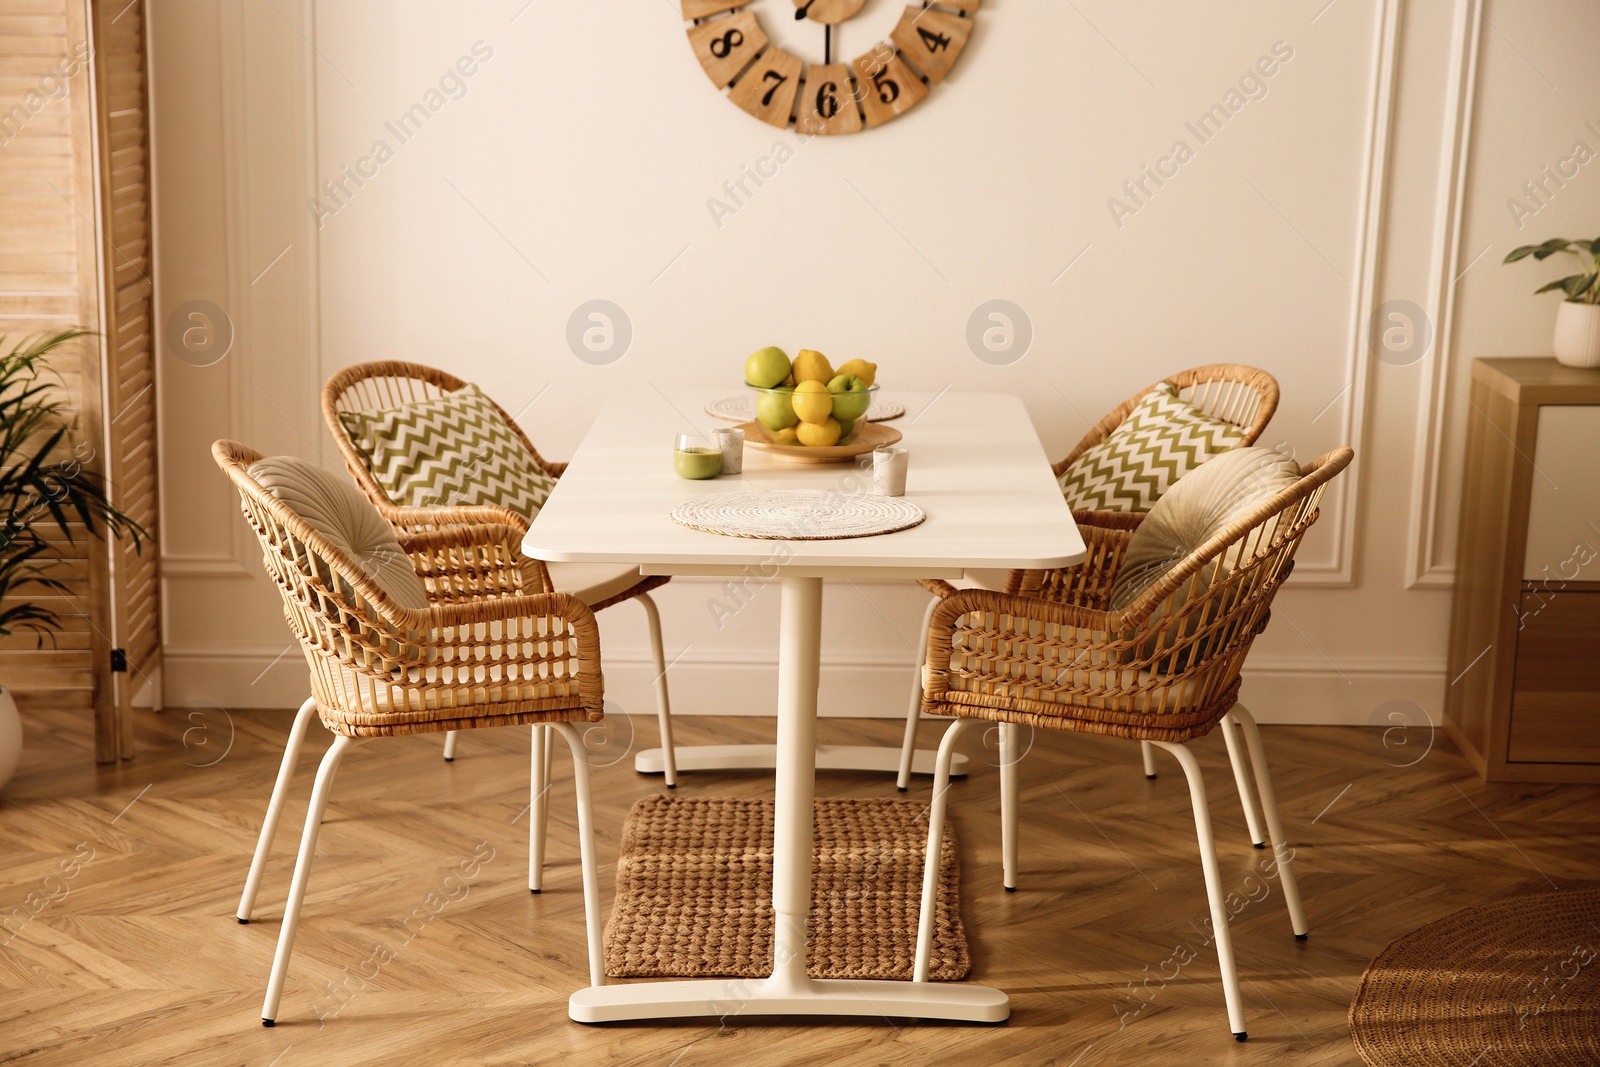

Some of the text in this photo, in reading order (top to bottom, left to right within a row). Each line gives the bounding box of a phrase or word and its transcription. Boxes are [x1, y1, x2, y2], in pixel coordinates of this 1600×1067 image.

[709, 28, 744, 59] 8
[915, 24, 952, 54] 4
[761, 69, 788, 107] 7
[815, 80, 839, 120] 6
[871, 63, 900, 105] 5
